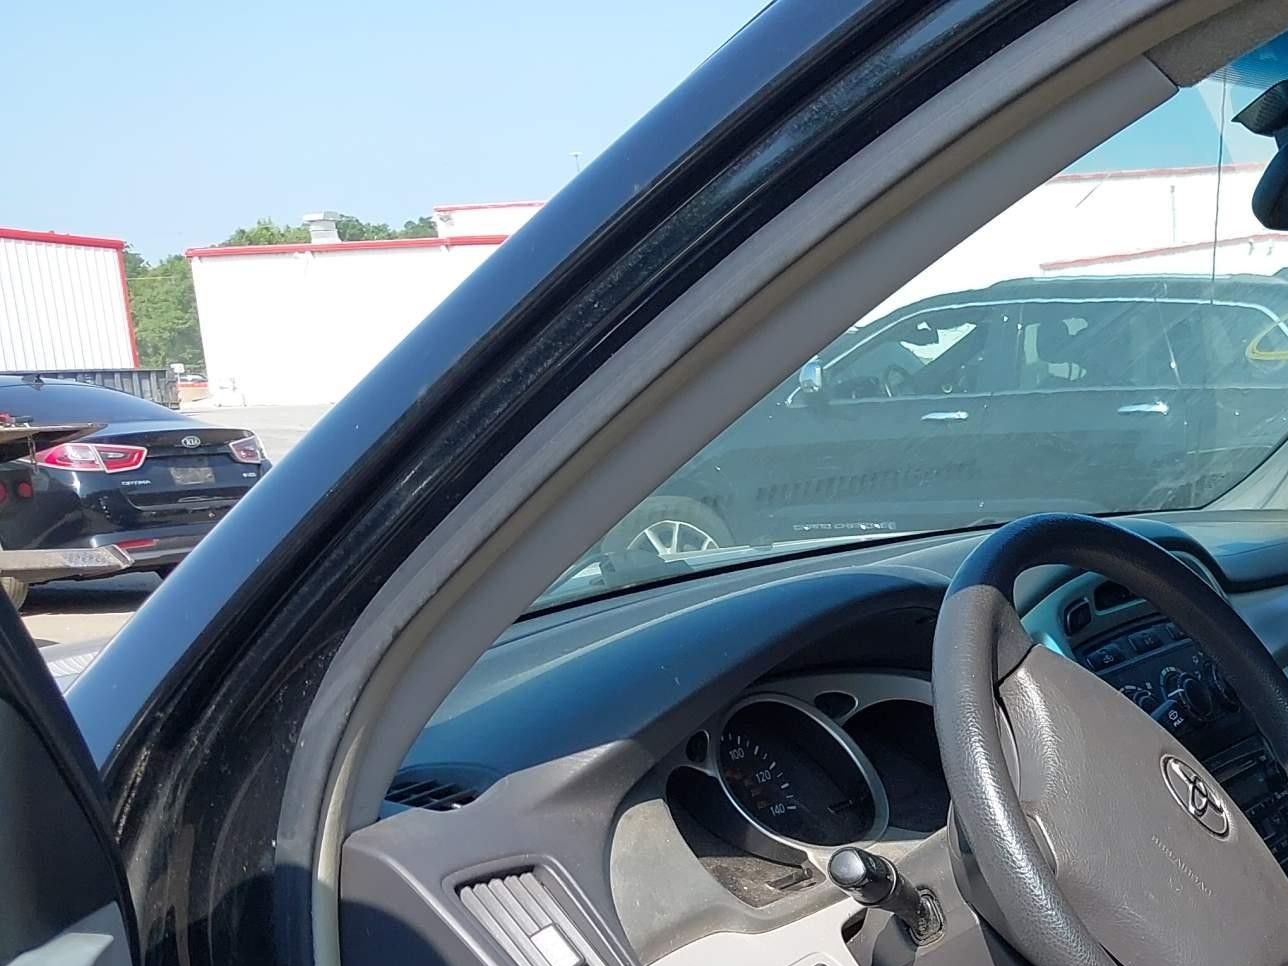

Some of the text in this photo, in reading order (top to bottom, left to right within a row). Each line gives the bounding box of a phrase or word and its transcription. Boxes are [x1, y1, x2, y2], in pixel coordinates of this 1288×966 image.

[728, 747, 745, 761] 100
[755, 770, 772, 784] 120
[770, 803, 786, 817] 140
